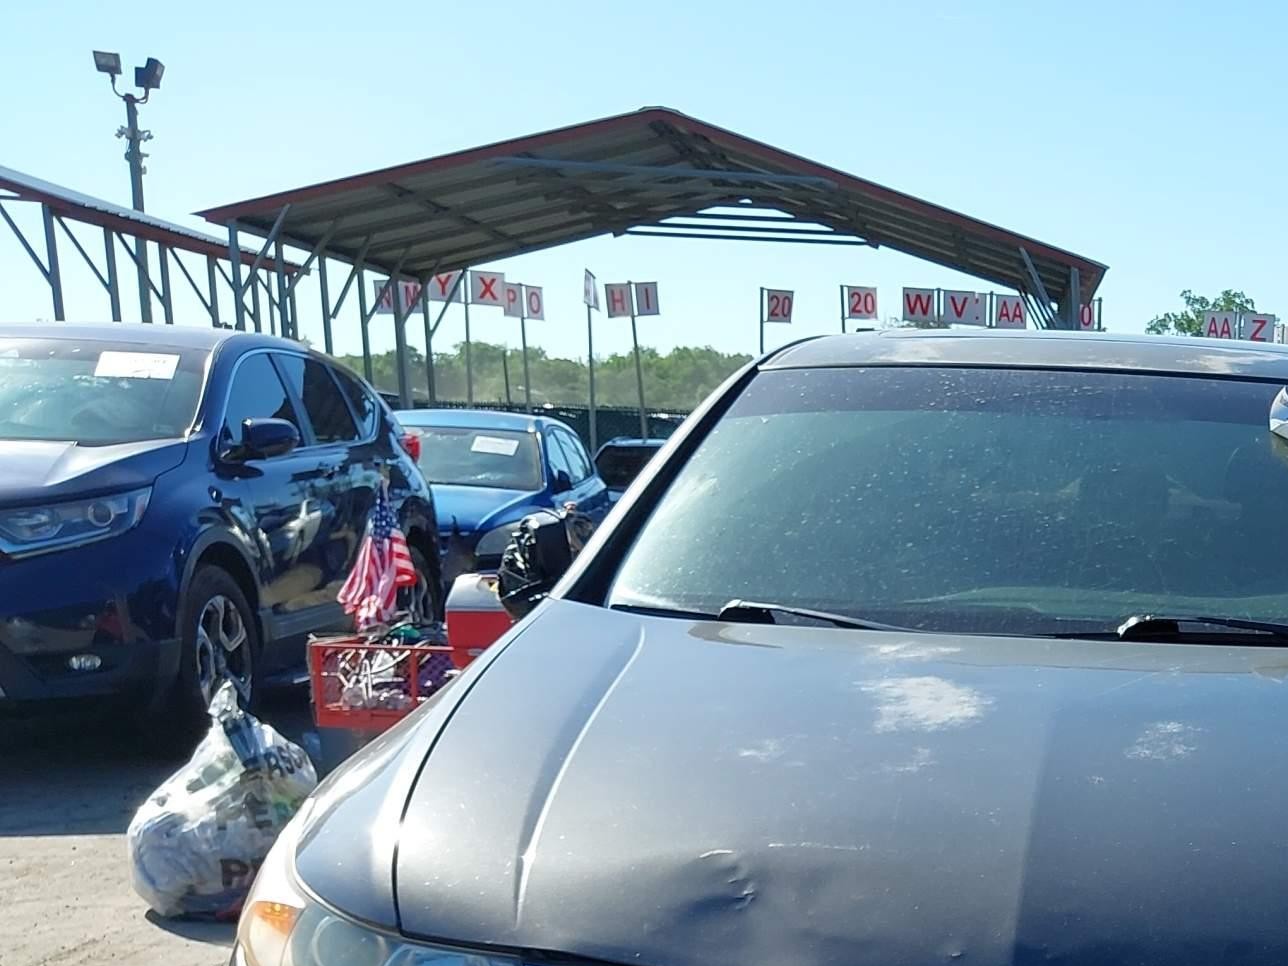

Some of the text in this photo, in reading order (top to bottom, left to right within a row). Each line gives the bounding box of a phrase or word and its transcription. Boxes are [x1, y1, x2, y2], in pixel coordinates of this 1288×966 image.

[436, 274, 452, 296] Y
[479, 276, 497, 300] X
[506, 288, 516, 312] P
[610, 289, 625, 312] H
[770, 295, 793, 317] 20
[851, 292, 875, 314] 20
[905, 293, 931, 316] W
[999, 300, 1024, 323] AA
[1207, 317, 1232, 339] AA
[1250, 320, 1267, 342] Z
